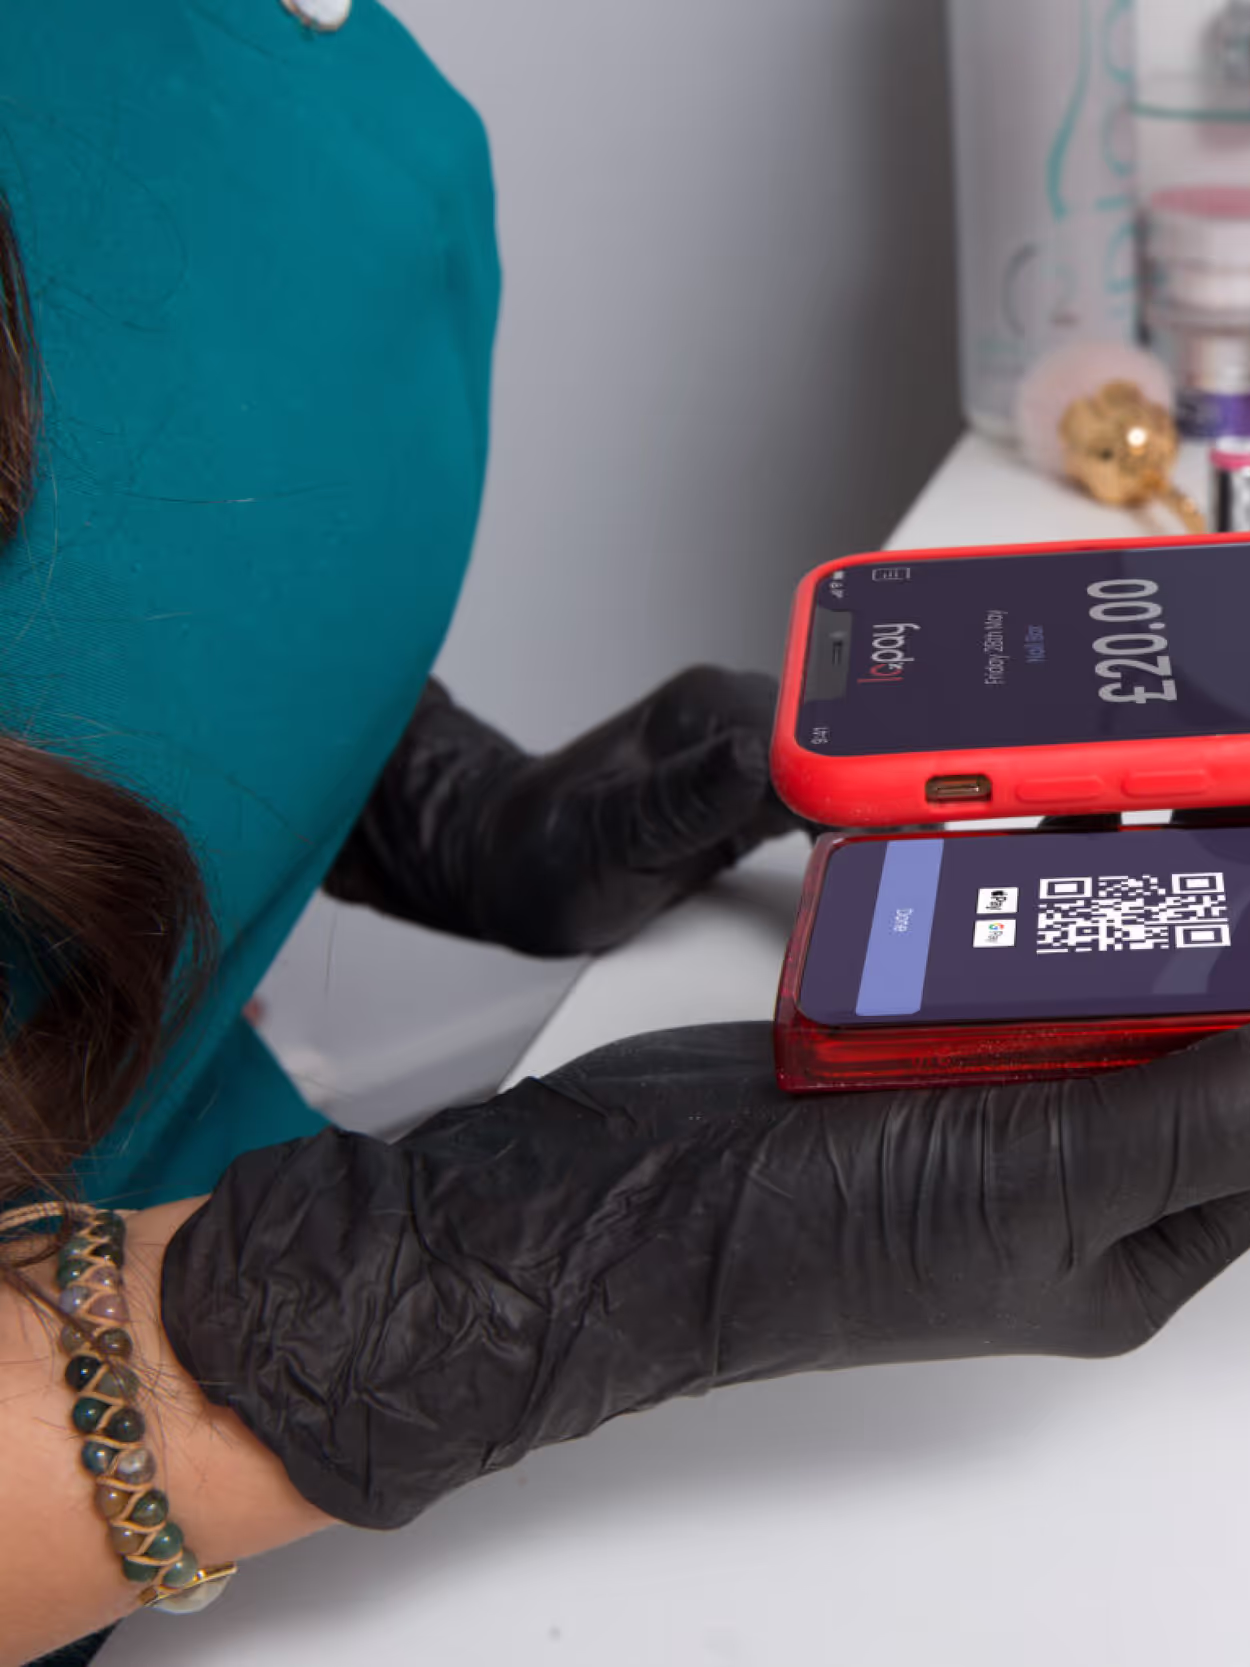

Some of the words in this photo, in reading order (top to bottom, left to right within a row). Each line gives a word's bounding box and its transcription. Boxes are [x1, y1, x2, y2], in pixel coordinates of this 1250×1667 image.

[984, 609, 1009, 630] May
[1086, 578, 1178, 704] £20.00
[984, 655, 1010, 685] Friday
